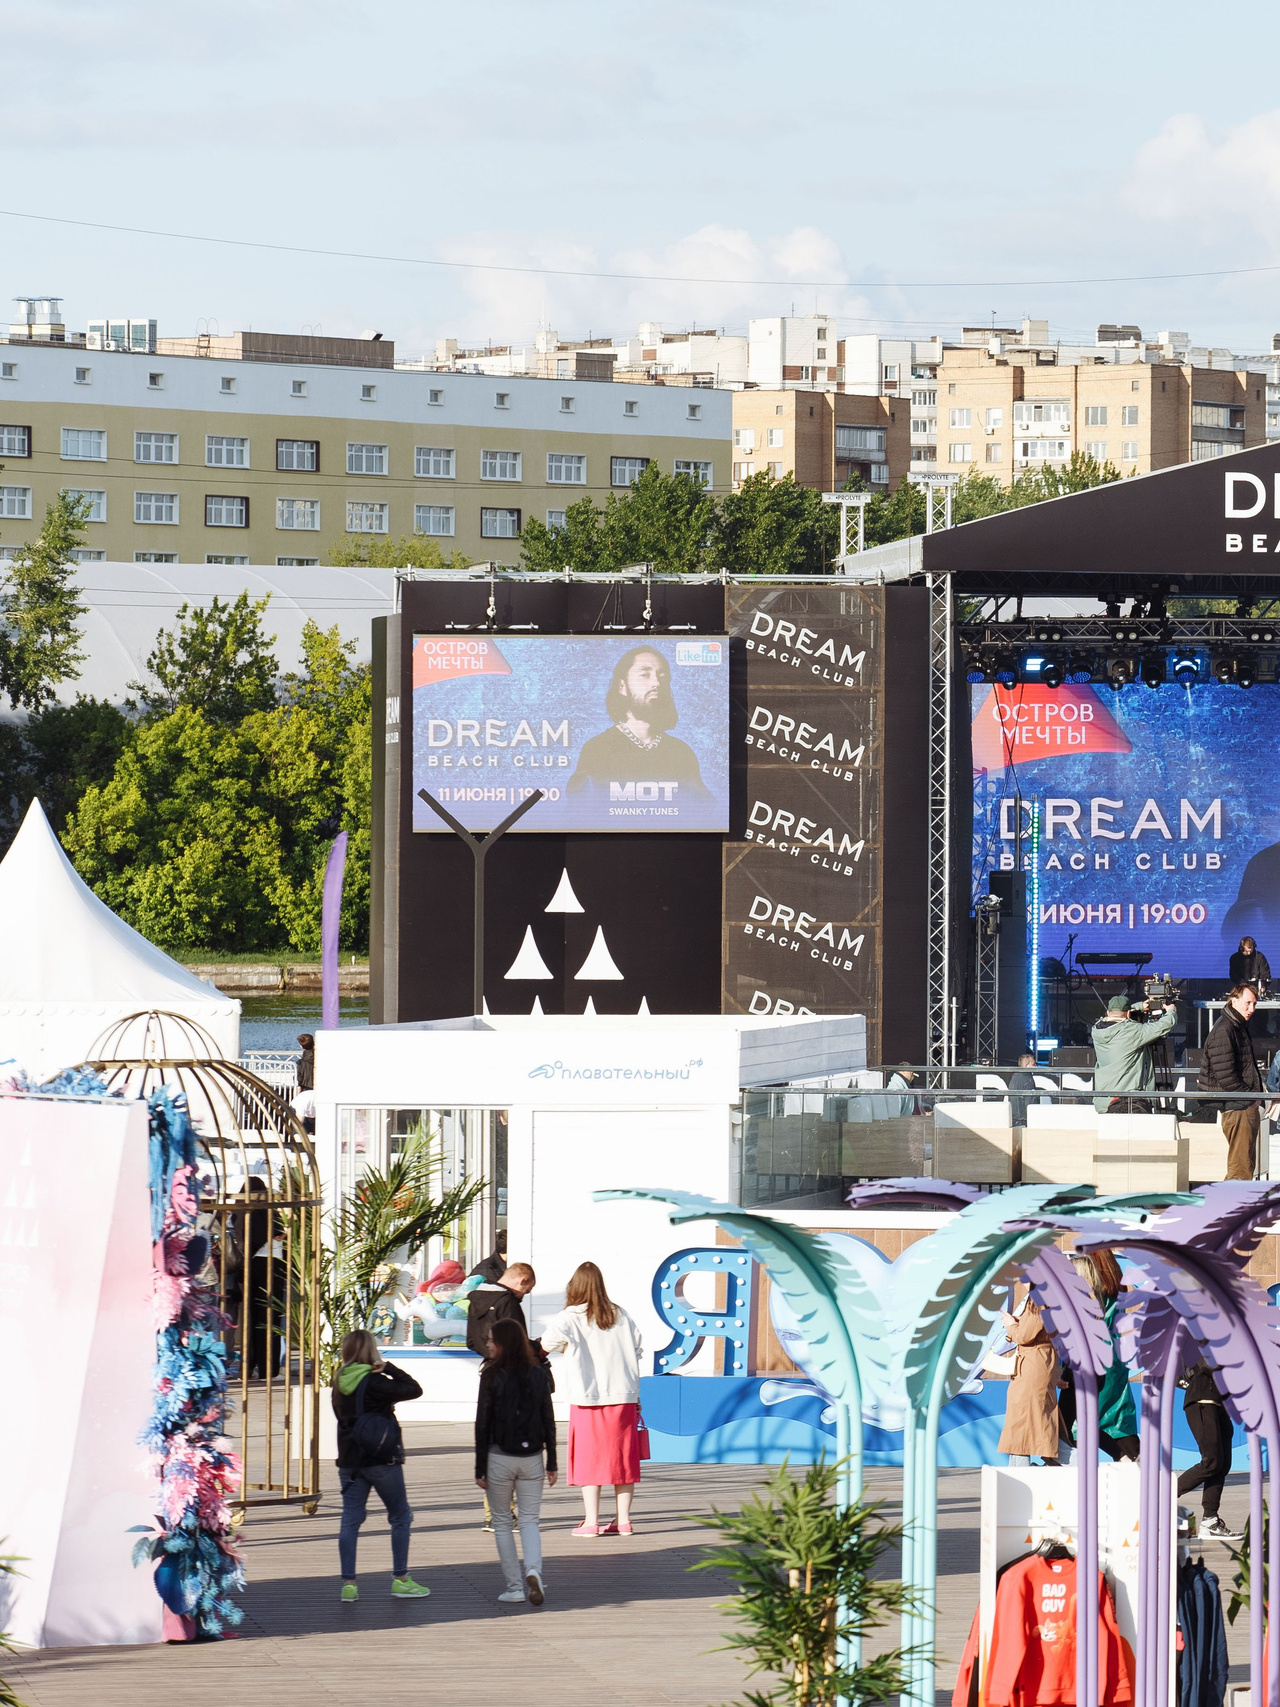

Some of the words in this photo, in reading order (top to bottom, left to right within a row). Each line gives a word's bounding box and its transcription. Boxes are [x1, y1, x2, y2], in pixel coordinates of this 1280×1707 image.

[423, 641, 488, 655] ОСТРОВ
[751, 611, 866, 672] DREAM
[428, 656, 484, 670] МЕЧТЫ
[745, 640, 800, 667] BEACH
[812, 665, 854, 687] CLUB
[992, 702, 1094, 723] ОСТРОВ
[428, 718, 569, 747] DREAM
[750, 706, 865, 767] DREAM
[999, 725, 1086, 745] МЕЧТЫ
[428, 755, 498, 767] BEACH
[513, 755, 569, 767] CLUB
[745, 735, 800, 762] BEACH
[811, 760, 853, 781] CLUB
[438, 788, 452, 800] 11
[454, 787, 507, 801] ИЮНЯ
[518, 787, 560, 801] 1900
[609, 807, 648, 816] SWANKY
[649, 807, 679, 816] TUNES
[1001, 797, 1221, 840] DREAM
[749, 801, 864, 861] DREAM
[745, 829, 799, 856] BEACH
[811, 854, 853, 875] CLUB
[1135, 853, 1222, 870] CLUB
[1039, 904, 1122, 924] ИЮНЯ
[1141, 904, 1206, 924] 19:00
[749, 896, 864, 956] DREAM
[744, 924, 799, 951] BEACH
[811, 949, 852, 970] CLUB
[1042, 1583, 1067, 1597] BAD
[1041, 1598, 1066, 1613] GUY
